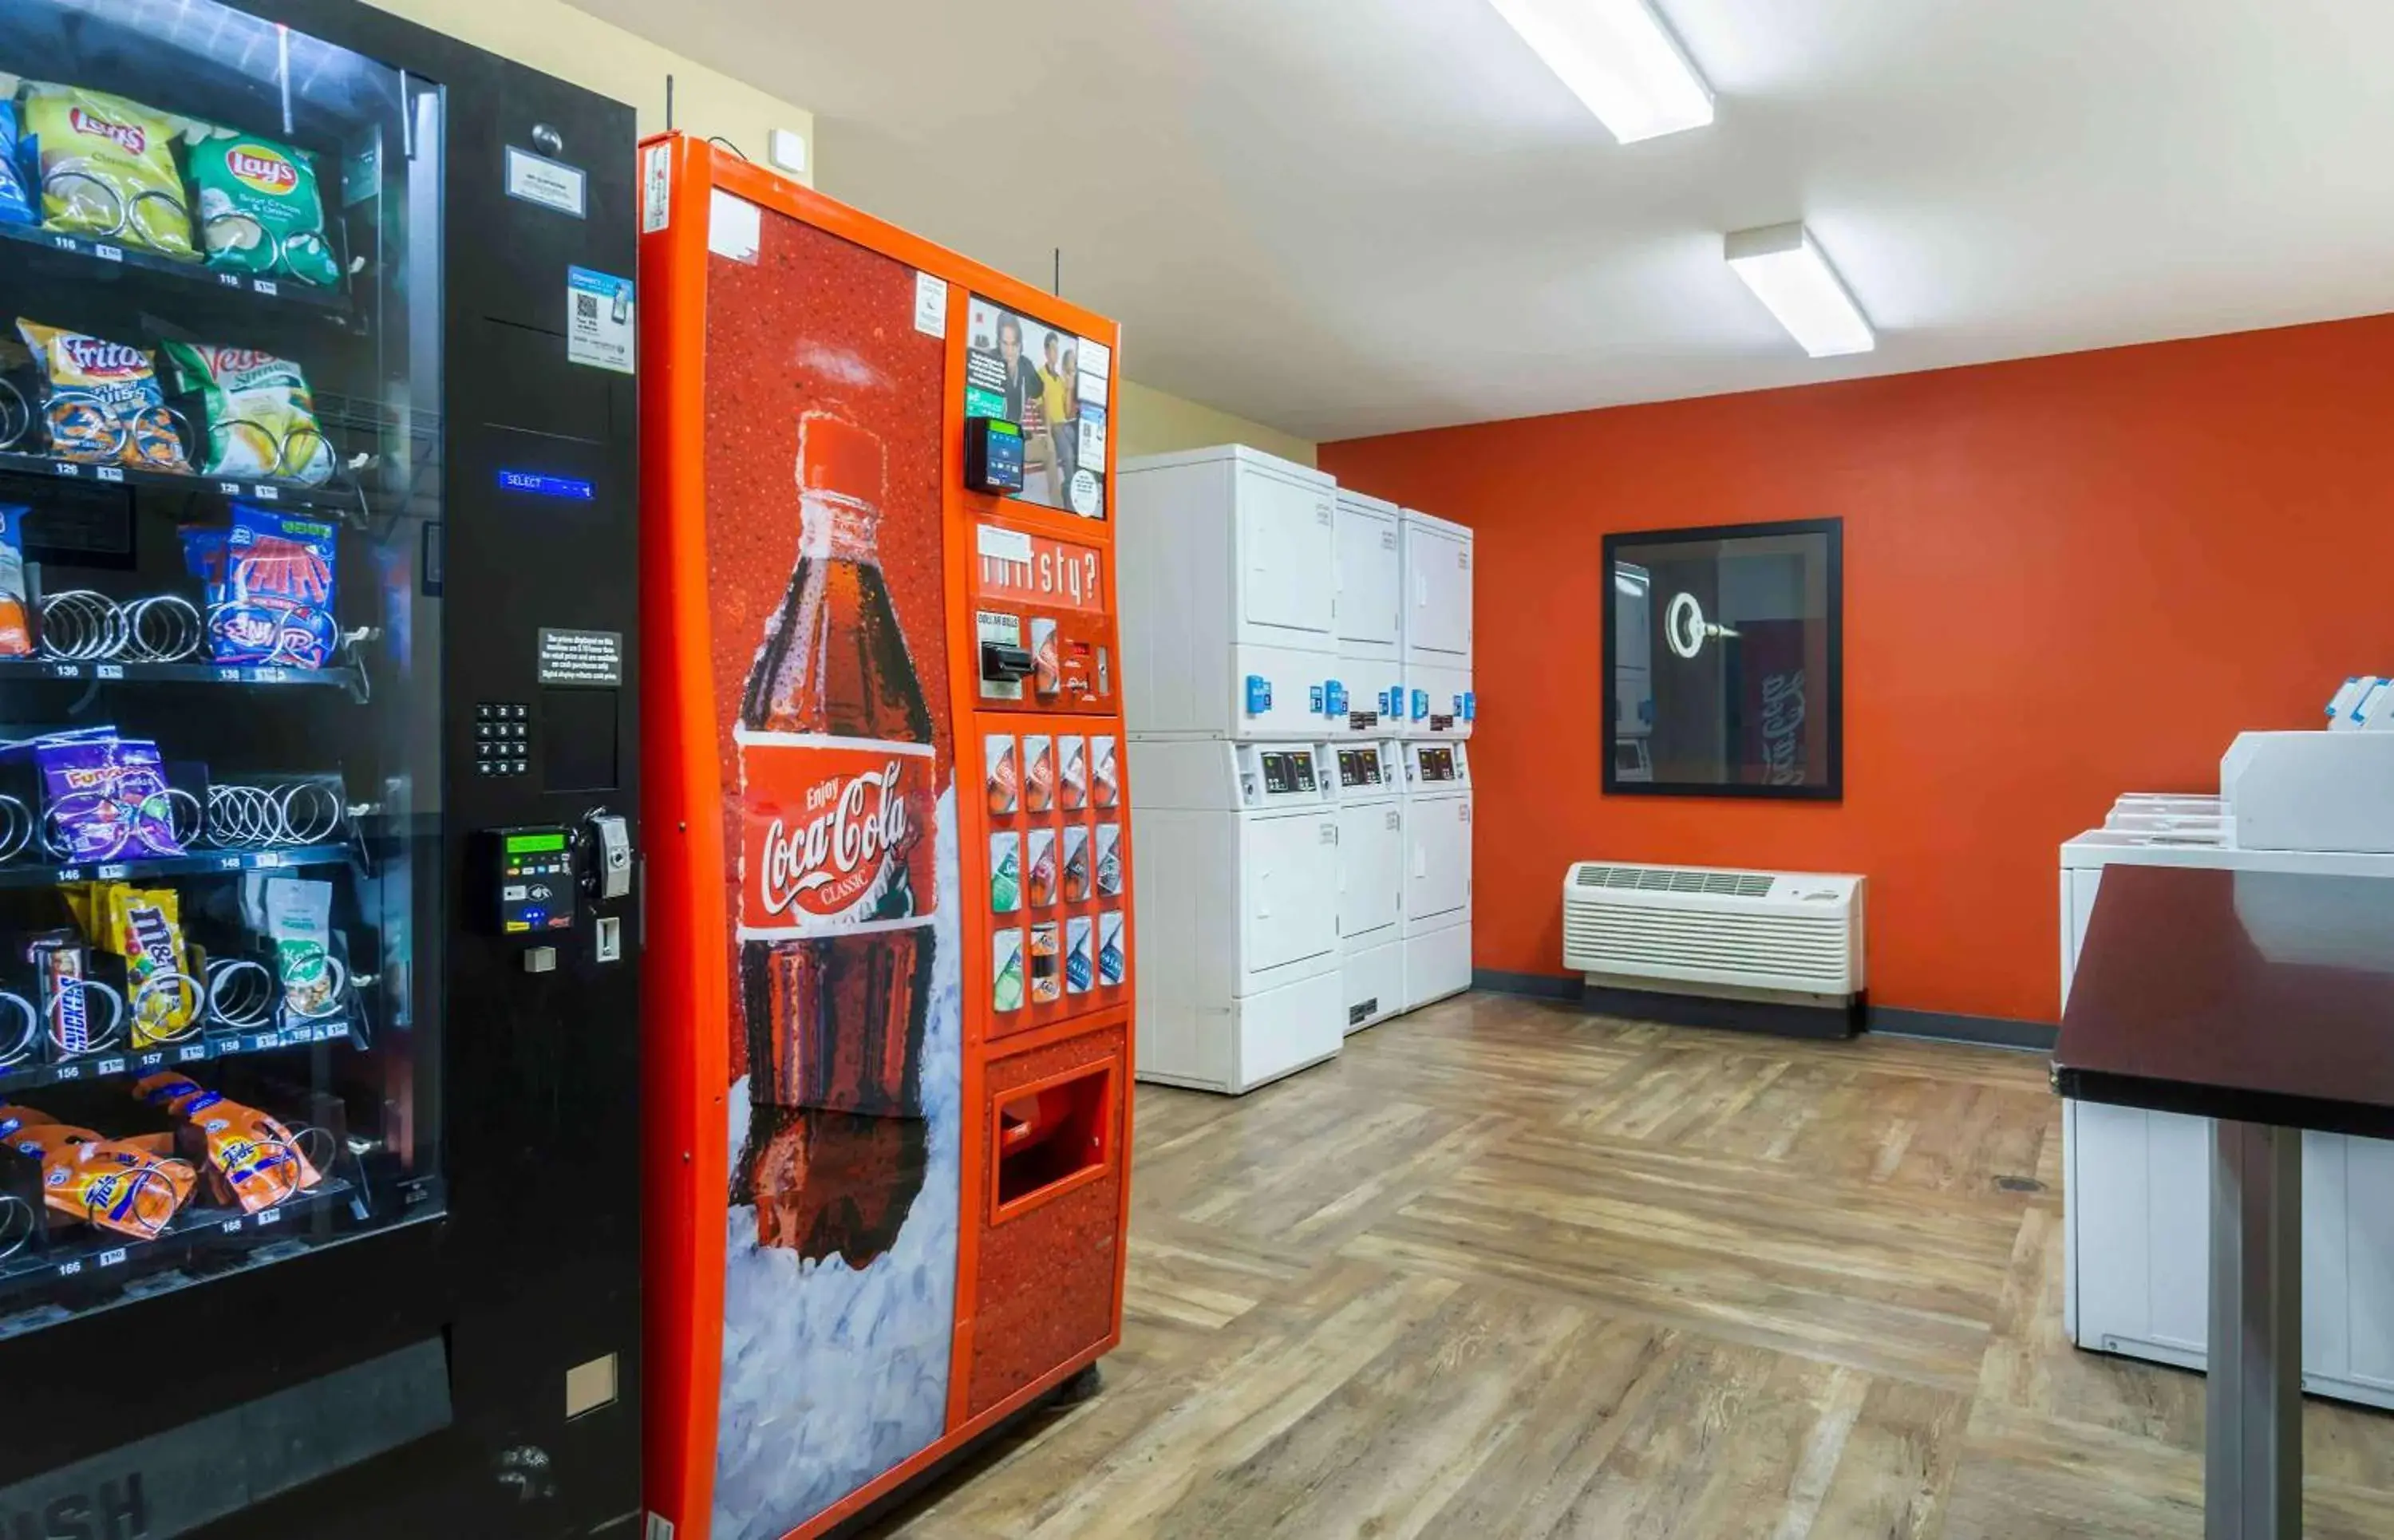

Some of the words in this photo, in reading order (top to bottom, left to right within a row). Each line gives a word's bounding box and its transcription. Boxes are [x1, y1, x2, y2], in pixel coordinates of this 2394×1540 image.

[233, 152, 294, 184] Lay's
[507, 475, 541, 488] SELECT
[806, 776, 839, 811] Enjoy
[761, 758, 907, 914] Coca-Cola
[820, 868, 870, 906] CLASSIC
[142, 1052, 163, 1064] 157
